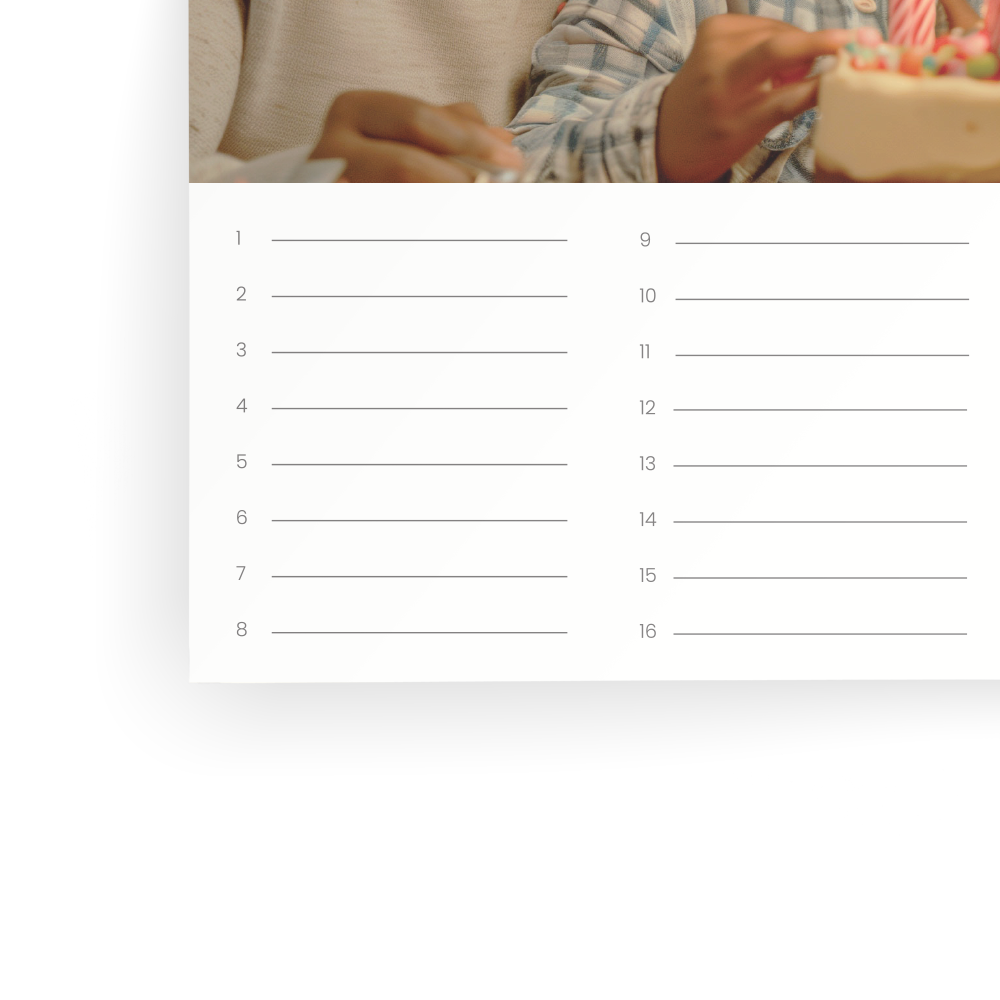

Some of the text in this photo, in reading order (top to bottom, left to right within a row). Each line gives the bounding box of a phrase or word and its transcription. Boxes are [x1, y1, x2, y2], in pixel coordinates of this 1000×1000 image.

[235, 230, 241, 246] 1
[639, 231, 651, 248] 9
[236, 285, 247, 302] 2
[639, 287, 657, 304] 10
[236, 341, 247, 358] 3
[639, 343, 650, 360] 11
[235, 397, 248, 414] 4
[639, 399, 656, 416] 12
[236, 453, 248, 470] 5
[639, 455, 656, 472] 13
[236, 509, 248, 525] 6
[639, 511, 657, 527] 14
[235, 565, 247, 581] 7
[639, 567, 657, 583] 15
[236, 621, 248, 638] 8
[639, 623, 657, 639] 16
